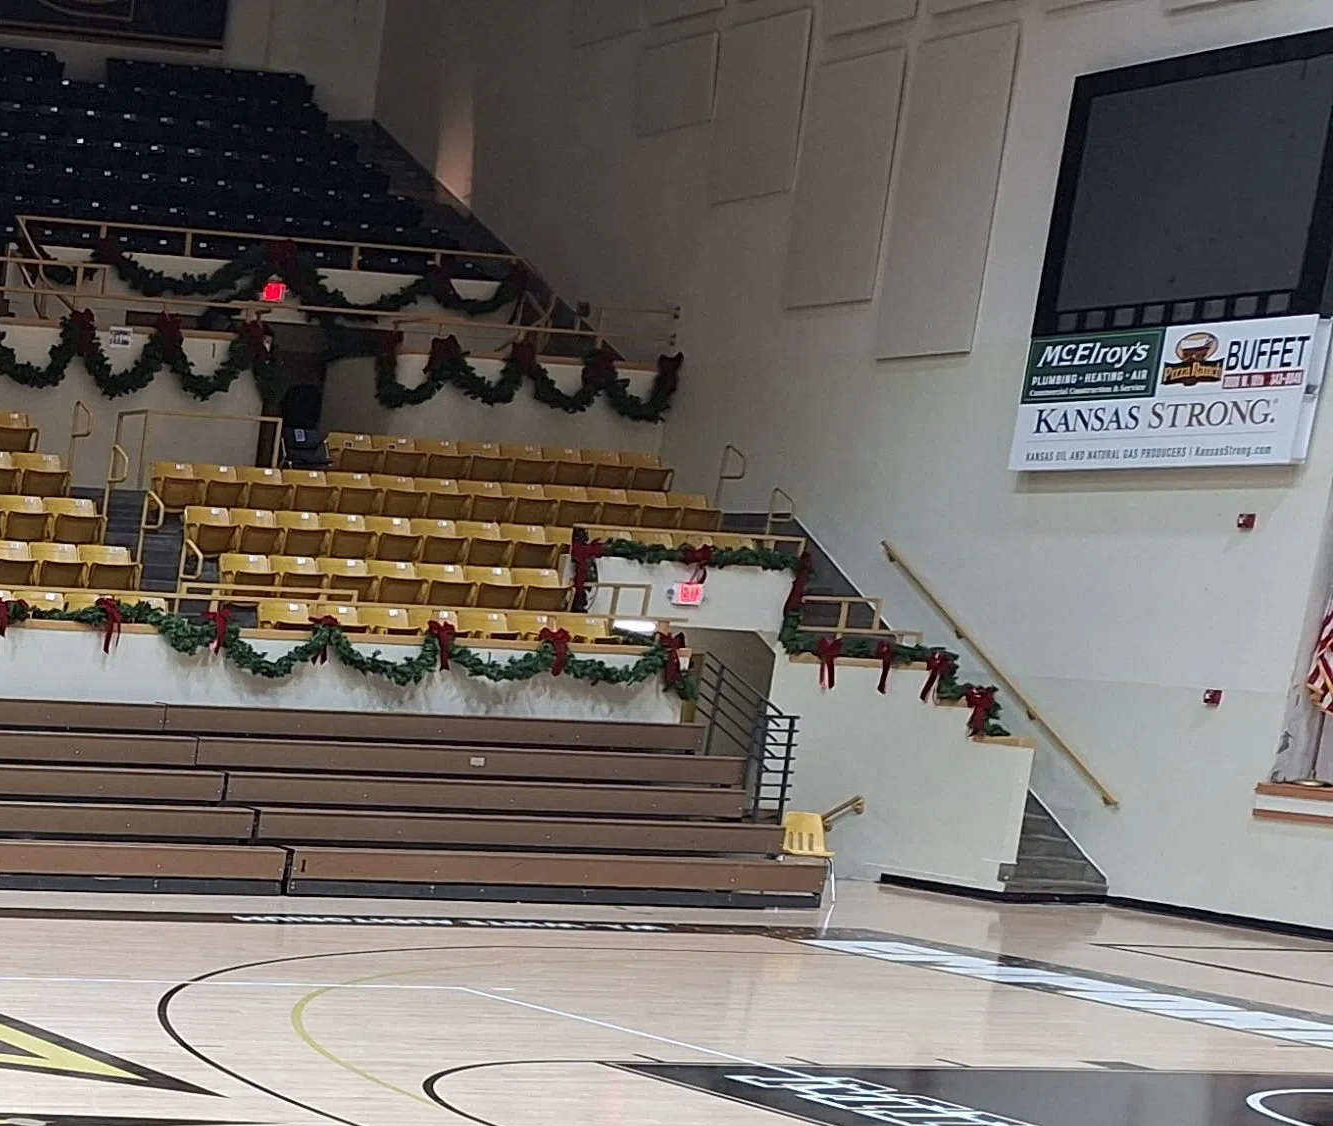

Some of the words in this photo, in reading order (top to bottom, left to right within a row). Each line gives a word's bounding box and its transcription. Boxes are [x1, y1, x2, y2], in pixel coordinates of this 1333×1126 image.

[1036, 340, 1151, 370] McElroy's
[1225, 335, 1311, 371] BUFFET
[1031, 373, 1078, 386] PLUMBING
[1084, 371, 1124, 383] HEATING
[1130, 369, 1148, 381] AIR
[1033, 404, 1142, 435] KANSAS
[1025, 450, 1054, 462] KANSAS
[1055, 450, 1068, 462] OIL
[1069, 450, 1085, 461] AND
[1087, 449, 1120, 461] NATURAL
[1122, 448, 1140, 459] GAS
[1140, 446, 1188, 459] PRODUCERS
[1194, 445, 1273, 458] KansasStrong.com
